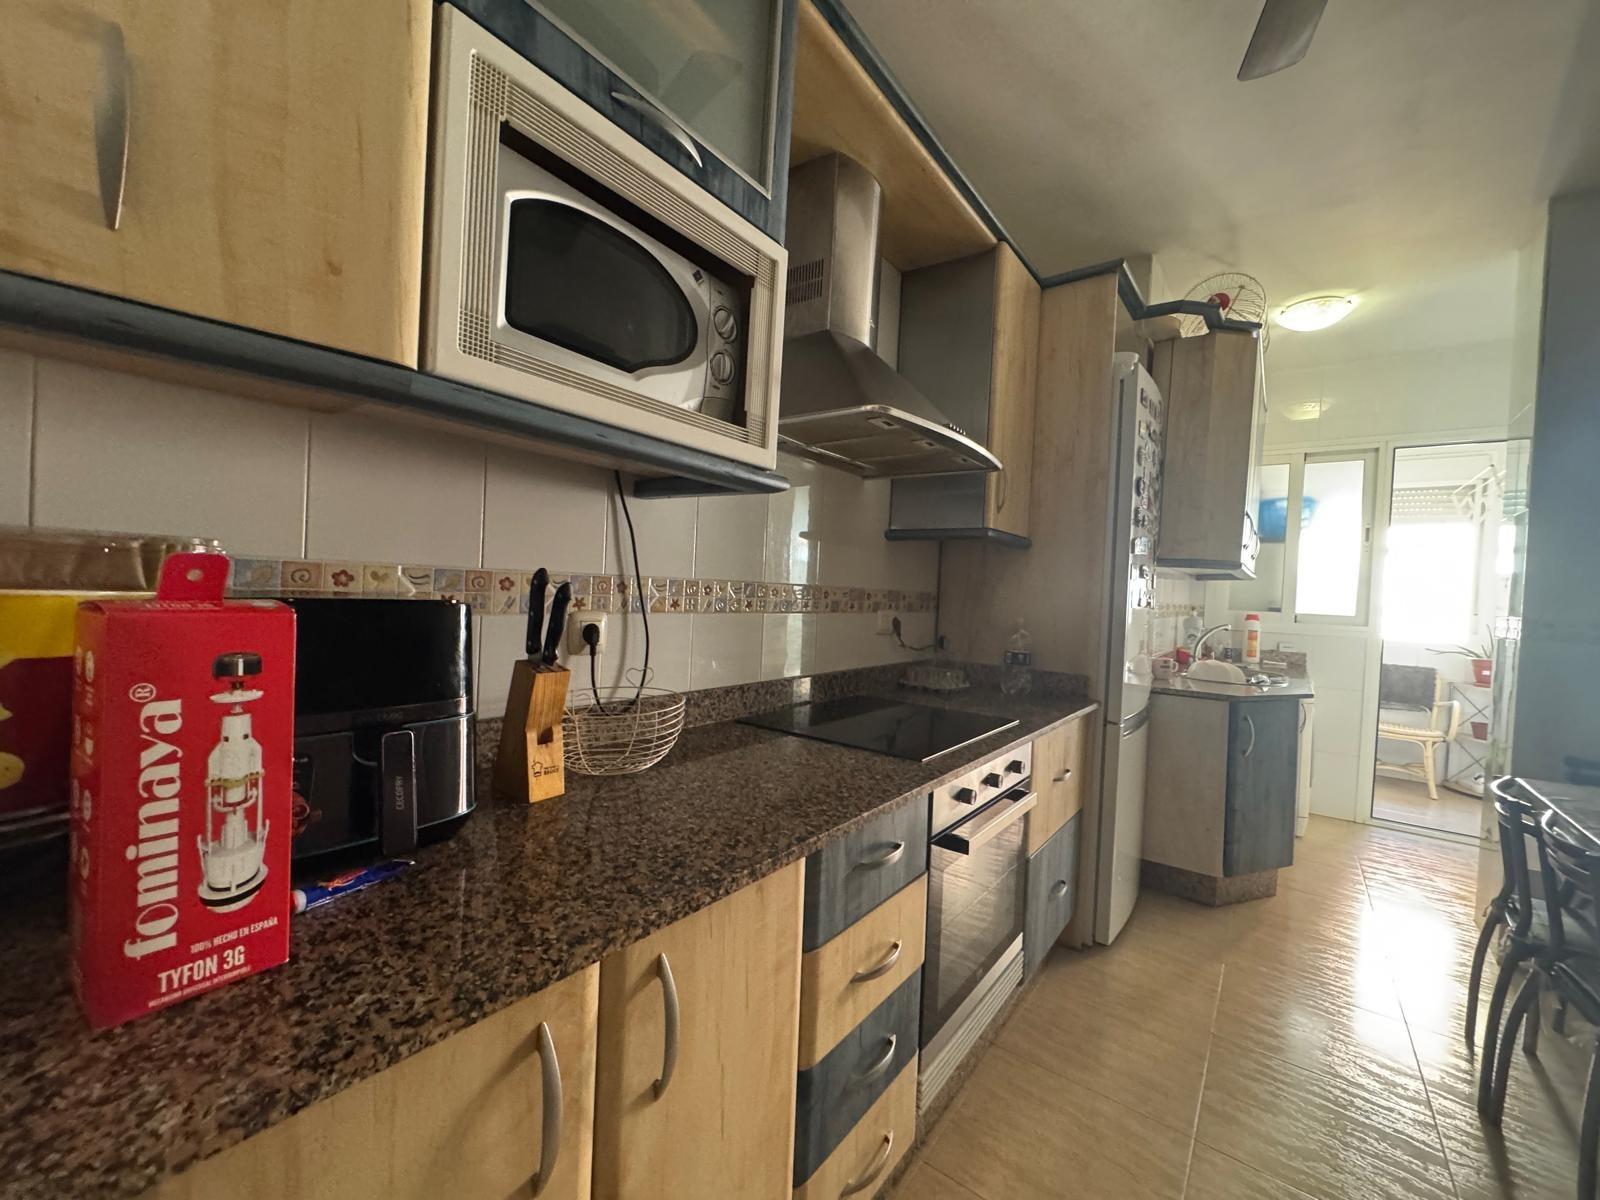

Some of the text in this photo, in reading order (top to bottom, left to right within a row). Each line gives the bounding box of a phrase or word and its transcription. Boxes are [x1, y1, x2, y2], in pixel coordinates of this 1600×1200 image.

[190, 916, 279, 954] 100% HECHO EN ESPAÑA
[158, 954, 218, 993] TYFON
[223, 945, 245, 970] 3G
